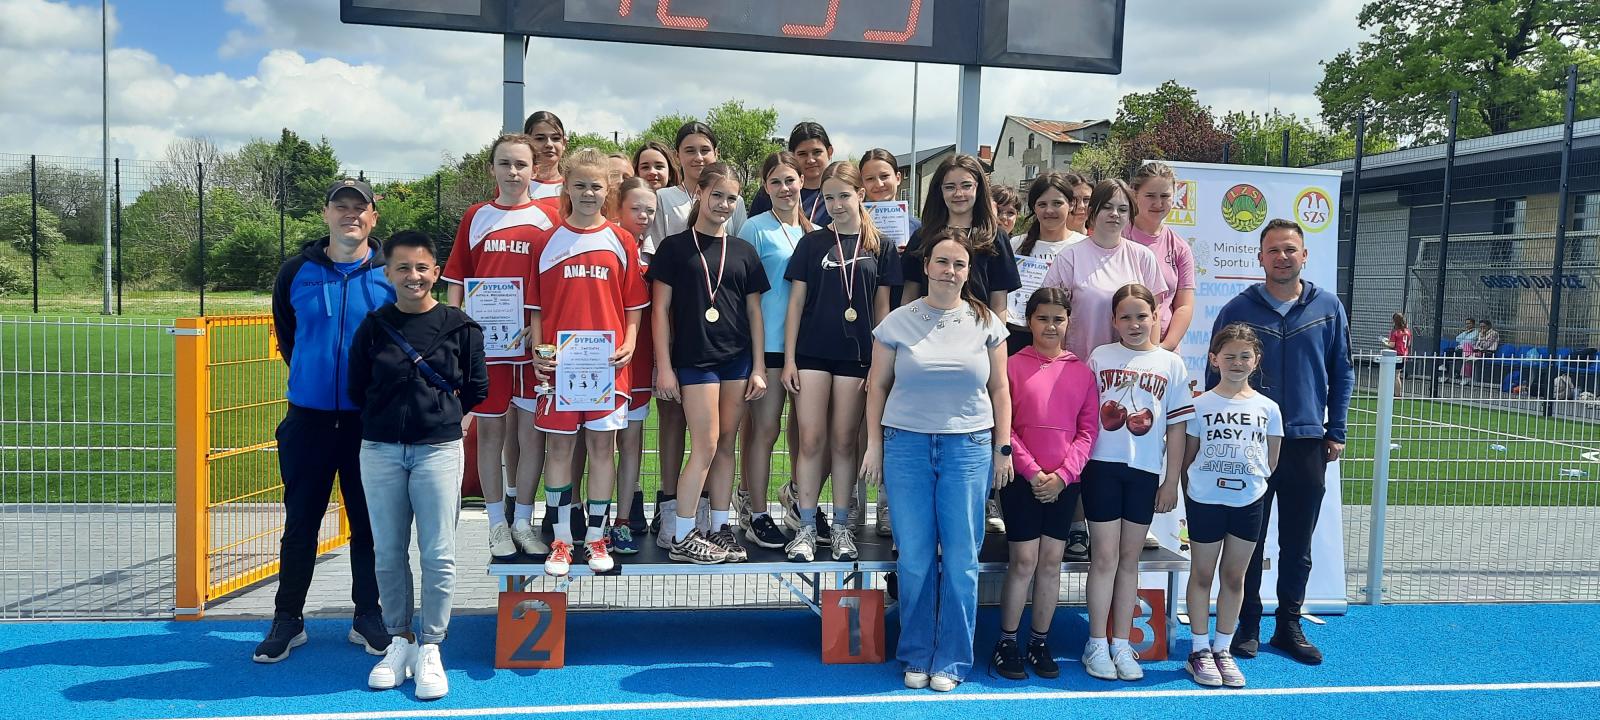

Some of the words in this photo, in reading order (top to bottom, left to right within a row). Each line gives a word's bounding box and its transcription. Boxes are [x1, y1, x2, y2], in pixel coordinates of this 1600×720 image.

[1229, 186, 1258, 199] LZS
[1165, 210, 1194, 223] ZLA
[1302, 211, 1326, 224] SZS
[484, 239, 531, 255] ANA-LEK
[1023, 262, 1048, 270] DYPLOM
[1214, 257, 1250, 269] Sportu
[563, 264, 610, 281] ANA-LEK
[1139, 372, 1168, 401] CLUB
[1202, 412, 1251, 426] TAKE
[1257, 415, 1268, 428] IT
[1206, 428, 1247, 441] EASY.
[1204, 444, 1241, 458] OUT
[1199, 460, 1256, 475] ENERG
[837, 595, 863, 656] 1
[1129, 595, 1155, 650] 3
[508, 599, 554, 662] 2
